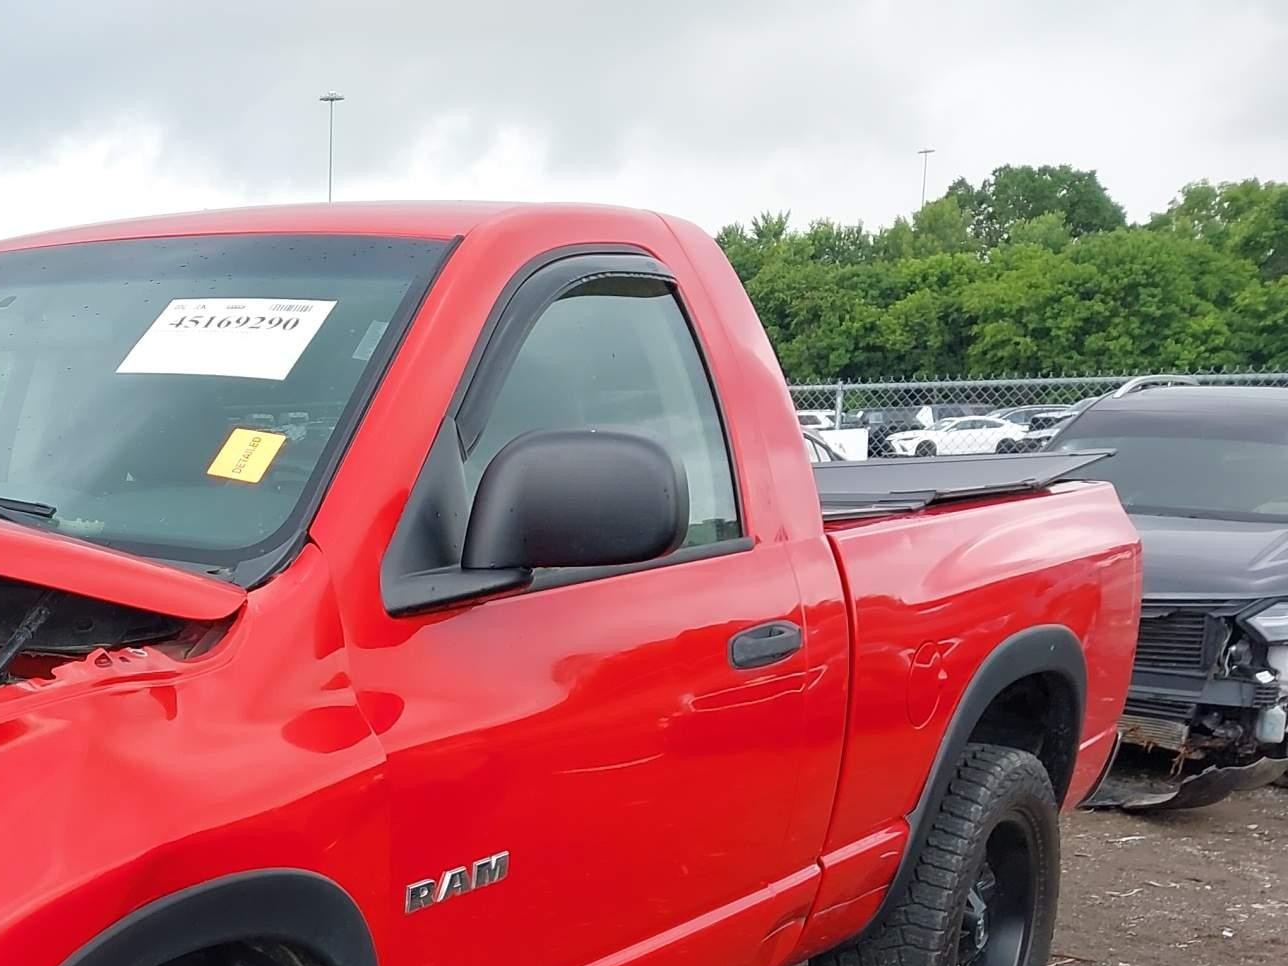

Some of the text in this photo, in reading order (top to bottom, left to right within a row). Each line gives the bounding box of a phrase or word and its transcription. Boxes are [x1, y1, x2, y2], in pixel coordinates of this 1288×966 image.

[169, 315, 300, 331] 45169290
[231, 436, 263, 474] DETAILED
[404, 850, 510, 914] RAM
